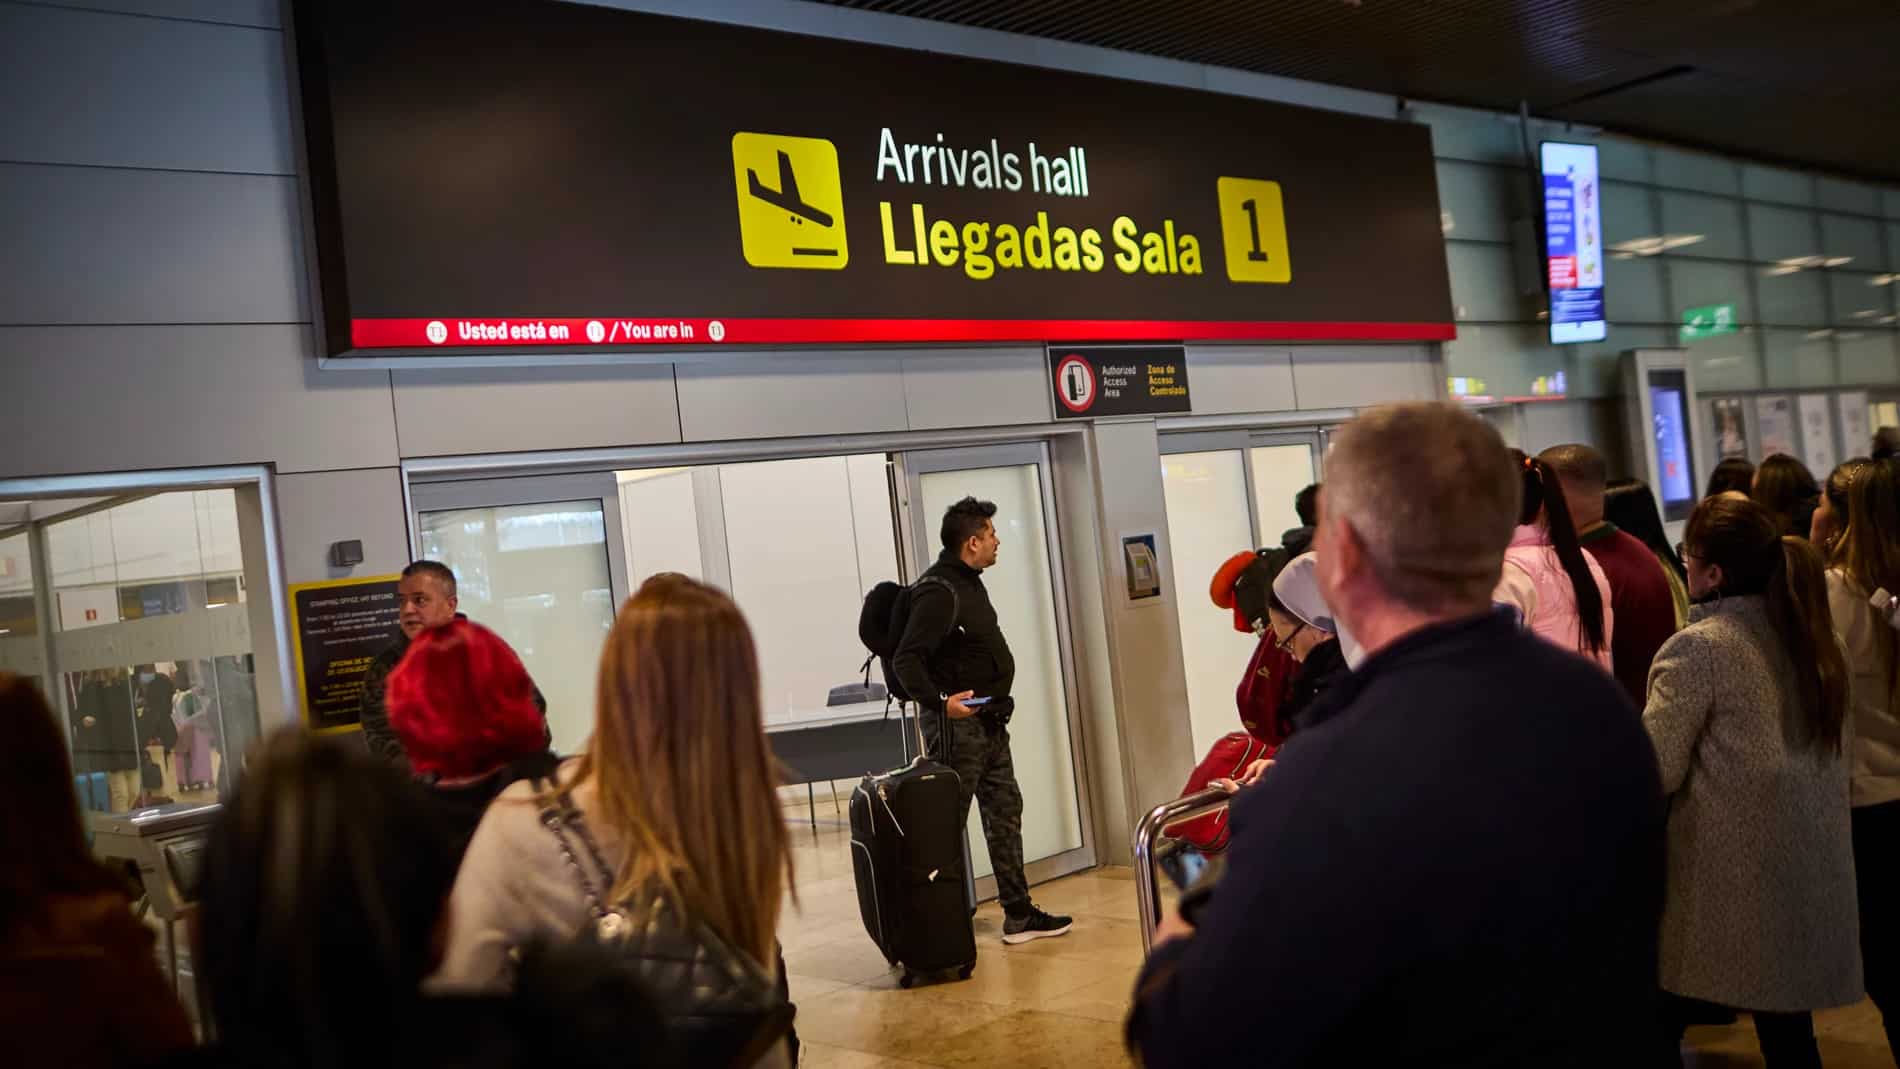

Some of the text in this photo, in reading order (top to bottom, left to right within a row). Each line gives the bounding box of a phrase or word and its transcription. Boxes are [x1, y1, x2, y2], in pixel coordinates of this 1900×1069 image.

[876, 127, 1089, 197] Arrivals hall
[1241, 198, 1268, 262] 1
[879, 201, 1203, 280] Llegadas Sala
[458, 321, 508, 340] Usted
[510, 321, 546, 340] está
[549, 325, 570, 339] en
[621, 321, 651, 339] You
[653, 325, 678, 339] are
[680, 321, 694, 338] in
[1102, 365, 1137, 376] Authorized
[1147, 364, 1176, 375] Zona de
[1103, 377, 1128, 387] Access
[1148, 375, 1174, 385] Acceso
[1104, 388, 1120, 398] Area
[1150, 386, 1186, 396] Controlado
